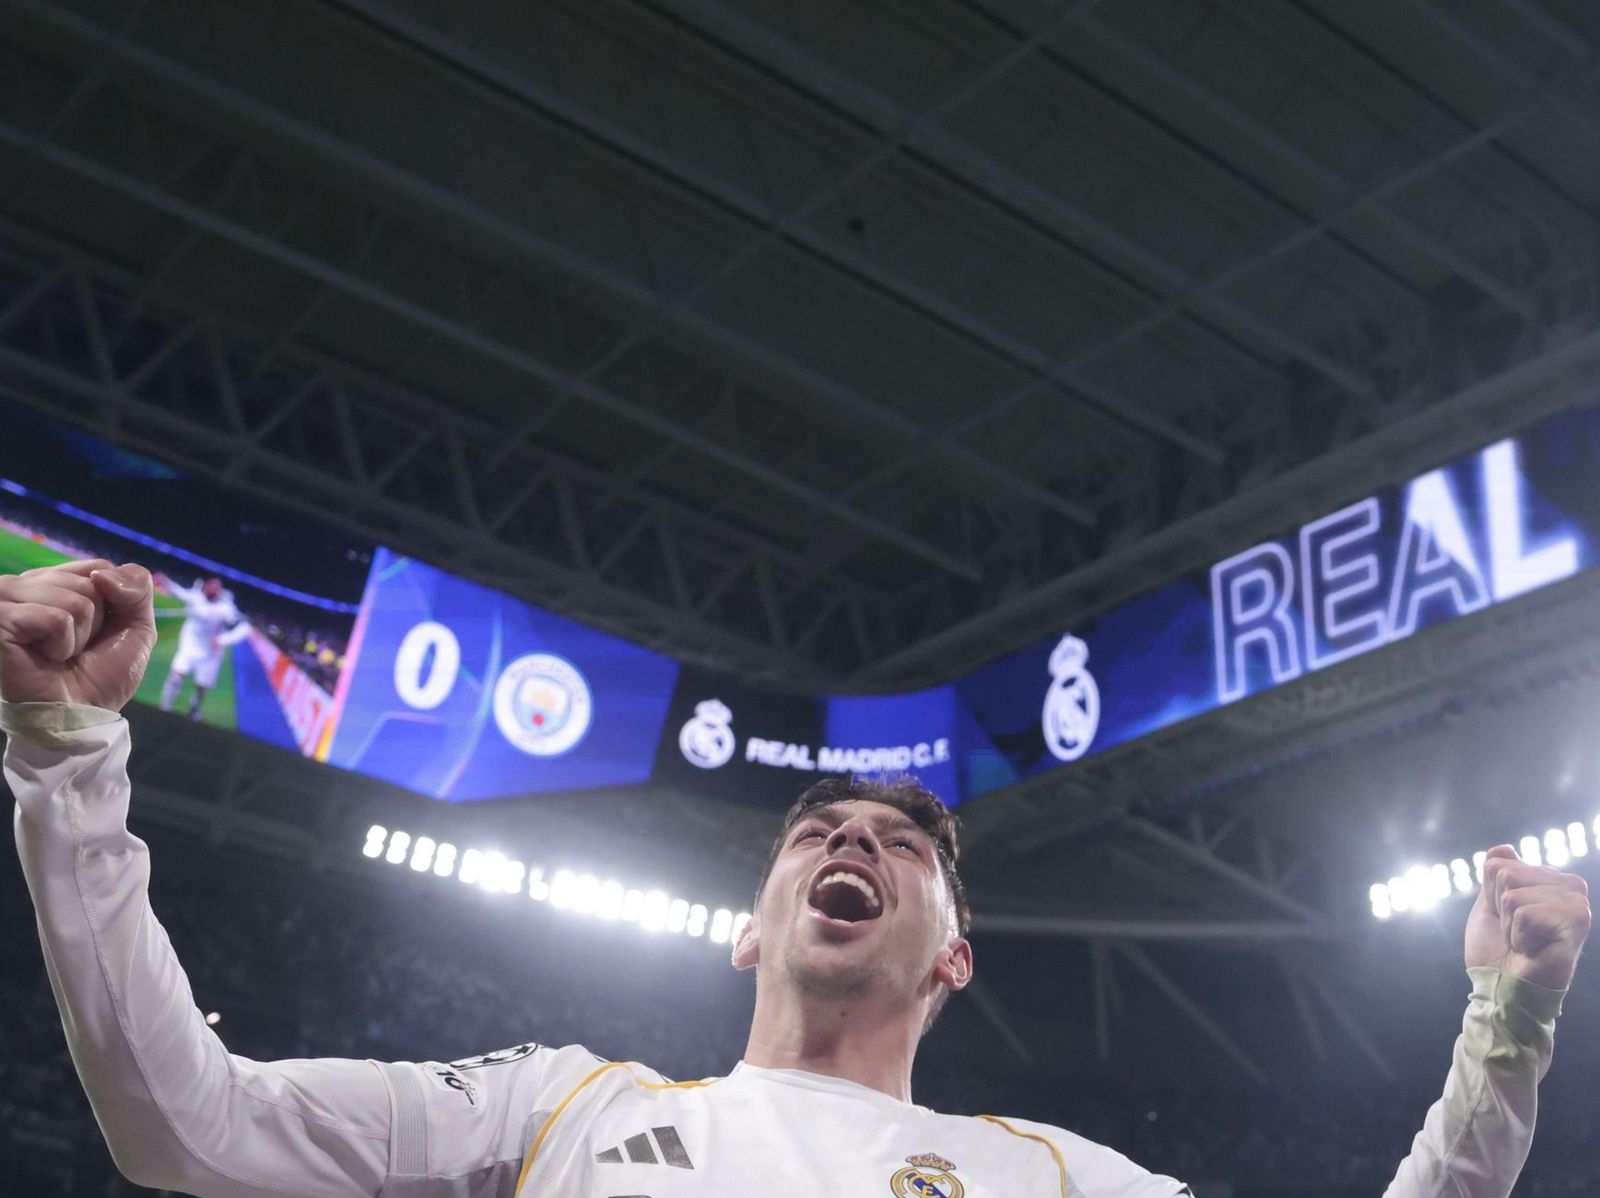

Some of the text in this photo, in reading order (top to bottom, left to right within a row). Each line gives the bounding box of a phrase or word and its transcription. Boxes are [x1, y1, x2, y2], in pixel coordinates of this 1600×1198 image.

[1210, 437, 1579, 704] REAL
[393, 620, 461, 710] 0
[746, 736, 816, 771] REAL
[817, 746, 912, 773] MADRID
